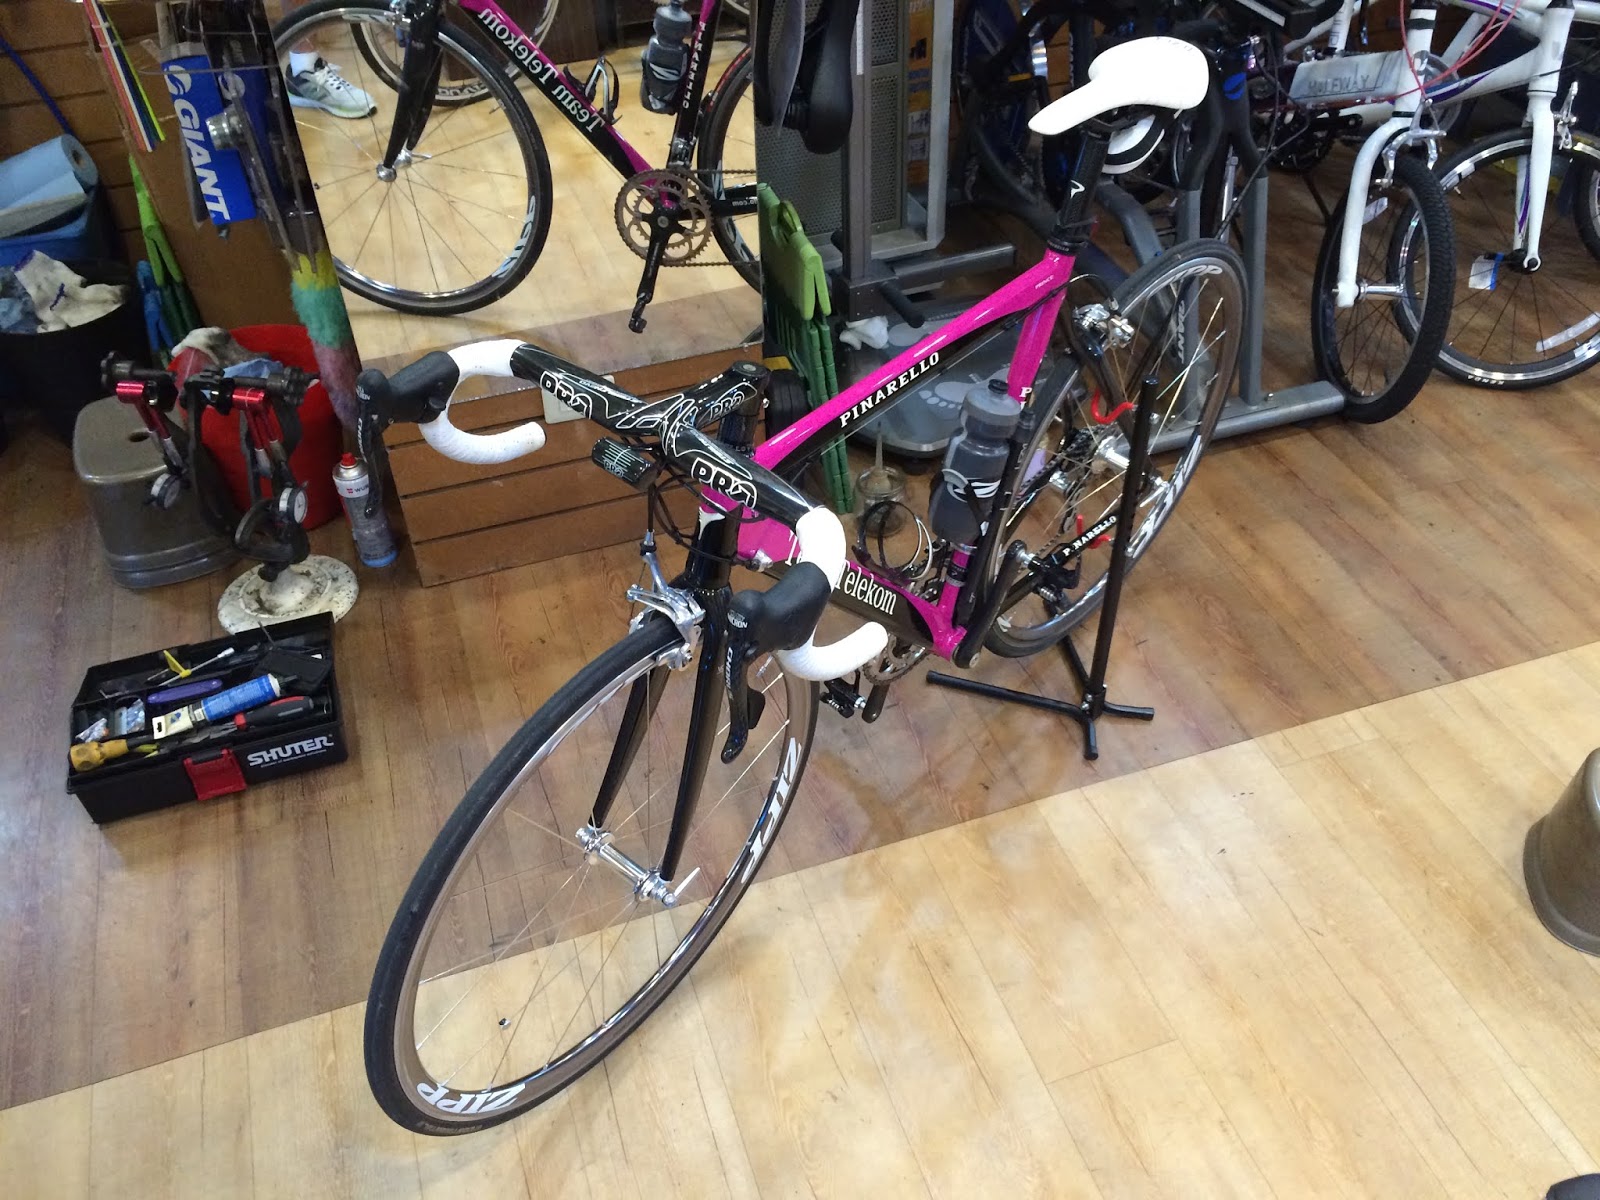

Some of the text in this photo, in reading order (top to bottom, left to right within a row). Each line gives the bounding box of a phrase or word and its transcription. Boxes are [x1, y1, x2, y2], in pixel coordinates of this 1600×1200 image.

[173, 98, 231, 221] GIANT
[840, 352, 940, 428] PINARELLO
[1467, 374, 1505, 385] KENDA
[1062, 515, 1117, 557] PNARELLO
[247, 736, 335, 767] SHUTER
[741, 737, 802, 884] ZIPP
[416, 1082, 526, 1114] ZIPP
